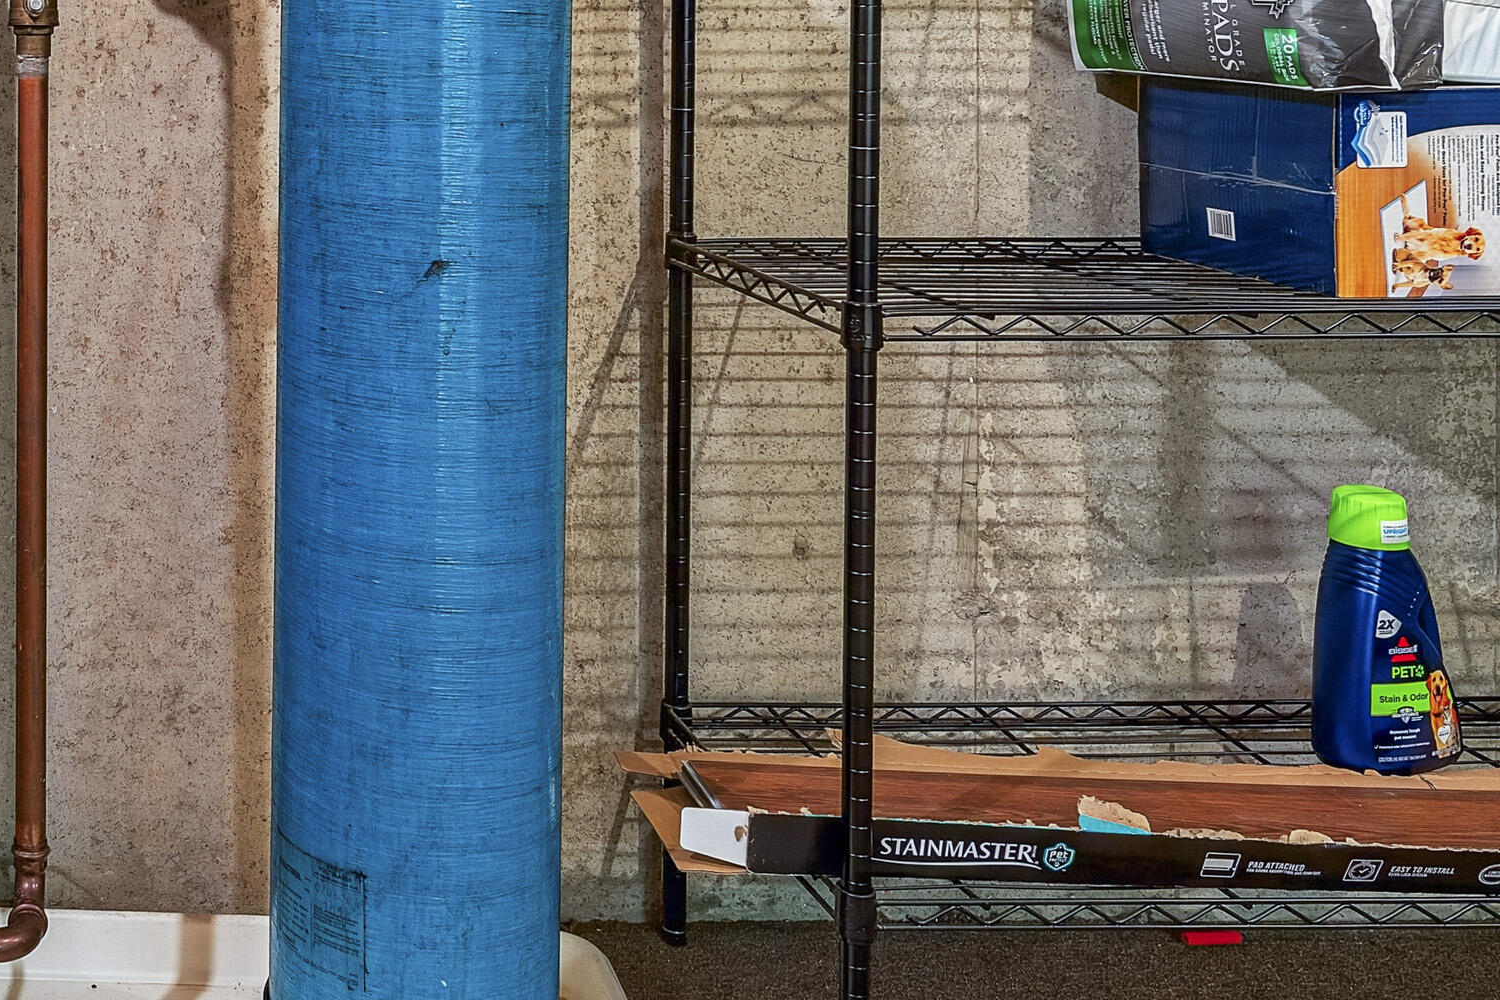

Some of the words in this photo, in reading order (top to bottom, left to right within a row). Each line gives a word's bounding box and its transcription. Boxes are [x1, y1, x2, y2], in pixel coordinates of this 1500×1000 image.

[1141, 3, 1150, 31] regular
[1124, 20, 1145, 71] PROTECTION
[1231, 19, 1245, 66] GRADE
[1281, 34, 1296, 54] 20
[1286, 55, 1298, 80] PADS
[1378, 619, 1396, 630] 2X
[1391, 666, 1416, 679] PET
[1379, 695, 1401, 703] Stain
[1409, 693, 1428, 701] Odor
[880, 837, 1034, 862] STAINMASTER
[1050, 850, 1068, 859] Pet
[1248, 861, 1264, 869] PAD
[1265, 862, 1306, 871] ATTACHED
[1423, 866, 1455, 874] INSTALL
